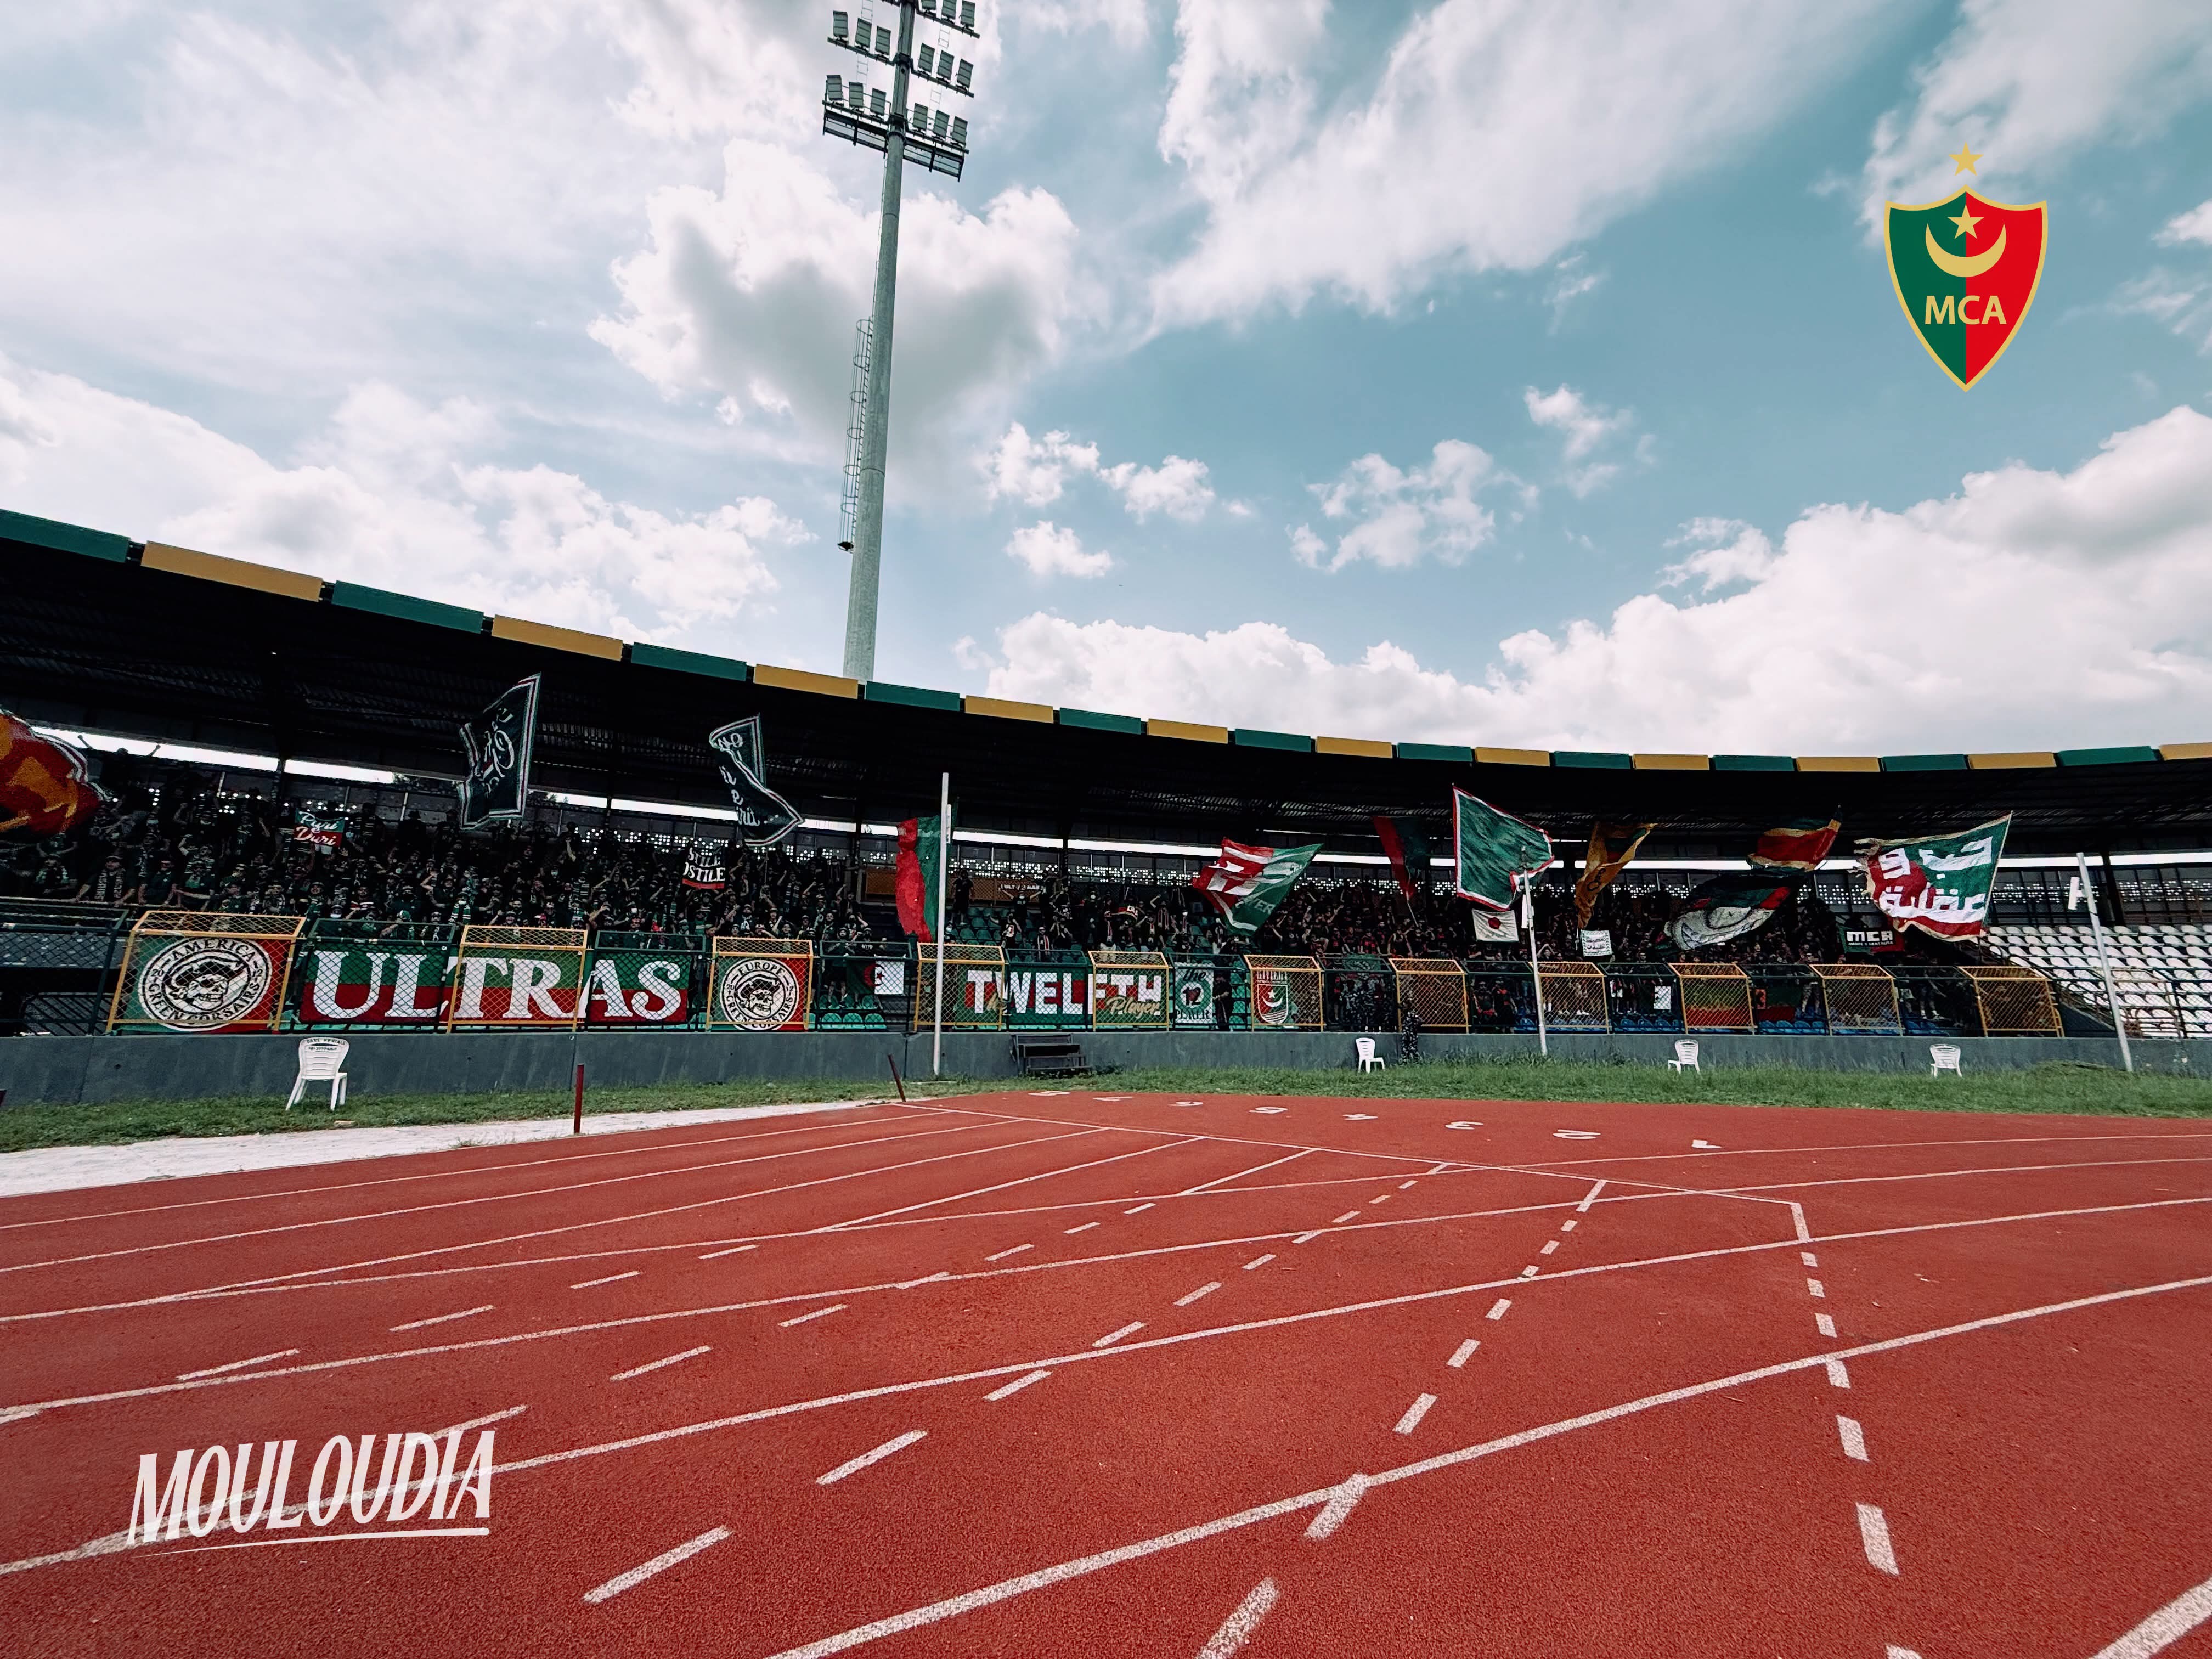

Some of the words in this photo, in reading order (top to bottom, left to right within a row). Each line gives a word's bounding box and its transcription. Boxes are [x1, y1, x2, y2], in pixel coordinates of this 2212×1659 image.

[298, 811, 338, 830] Puri
[294, 826, 336, 845] Duri
[1847, 931, 1893, 942] MCA
[172, 937, 257, 961] AMERICA
[150, 969, 163, 977] 20
[737, 961, 786, 977] EUROPE
[313, 950, 682, 1020] ULTRAS
[967, 970, 1162, 1015] TWELFTH
[148, 983, 184, 1022] GREEN
[726, 995, 751, 1026] GREEN
